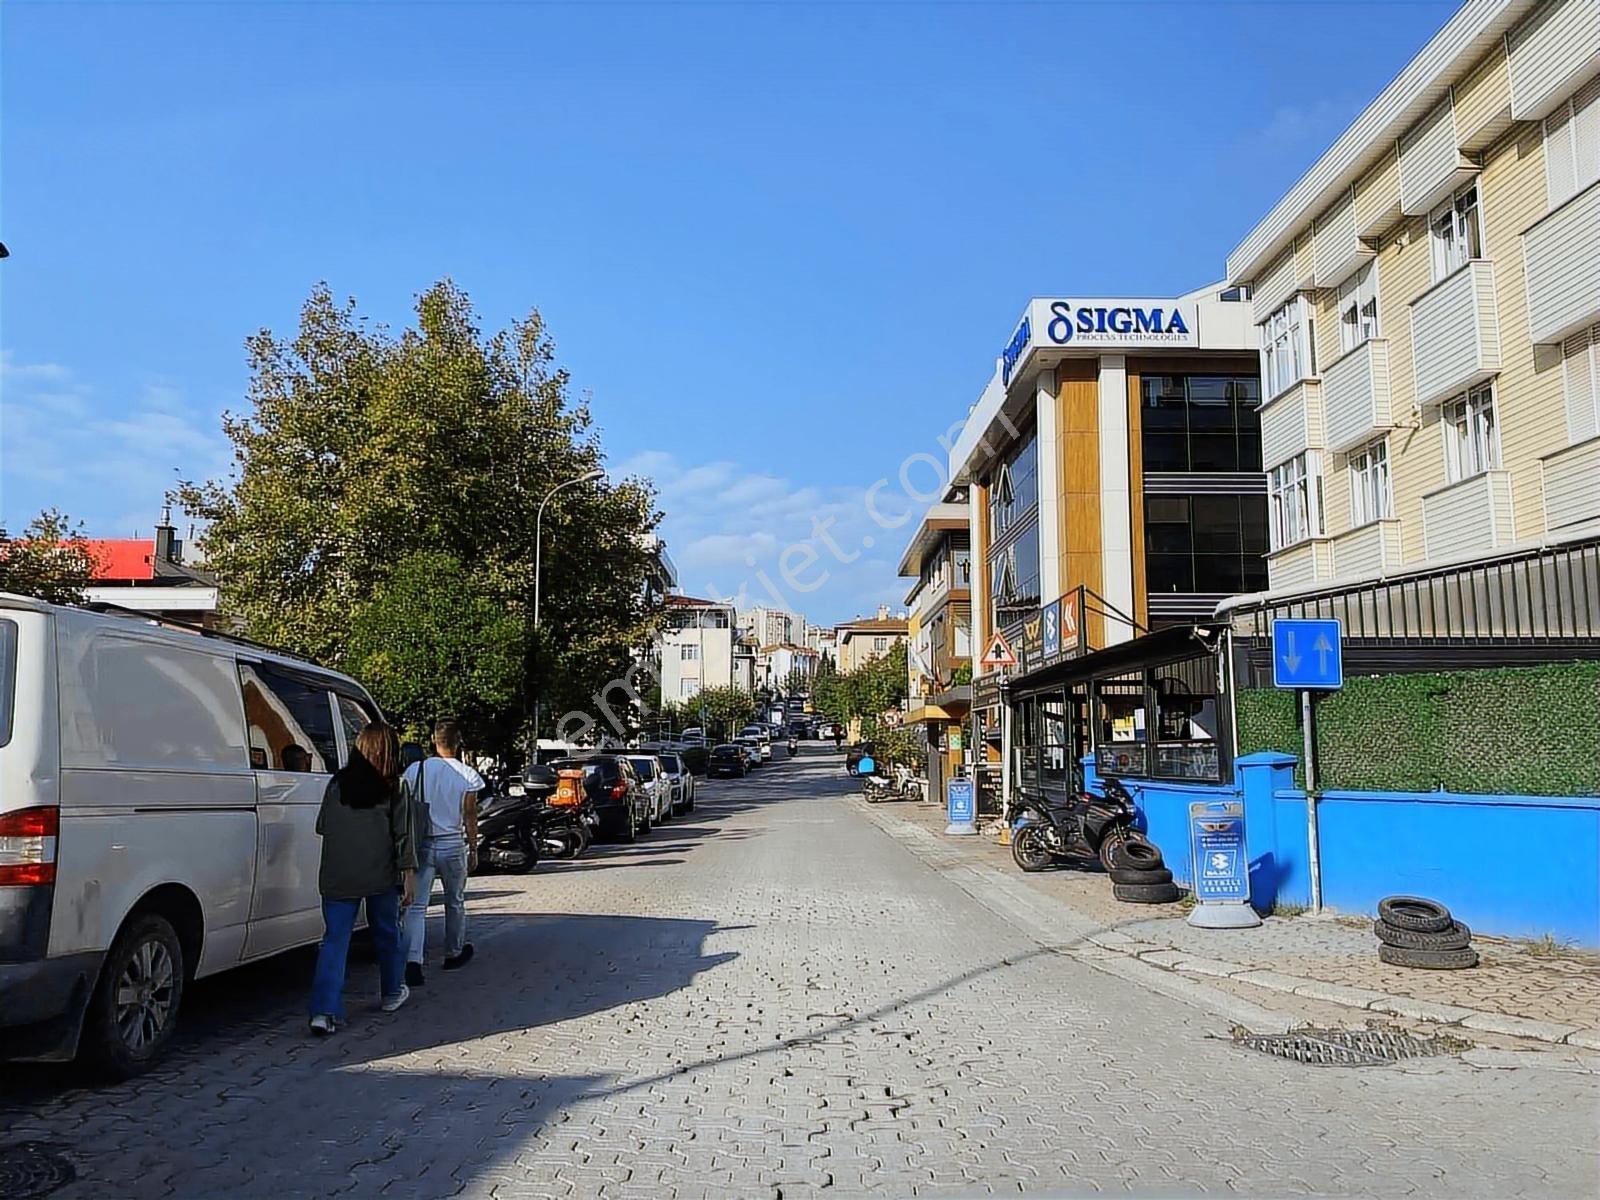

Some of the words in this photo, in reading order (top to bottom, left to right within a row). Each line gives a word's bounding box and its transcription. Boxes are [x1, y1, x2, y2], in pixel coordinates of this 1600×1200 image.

[1076, 307, 1189, 334] SIGMA
[1076, 333, 1116, 341] PROCESS
[1119, 333, 1188, 341] TECHNOLOGIES
